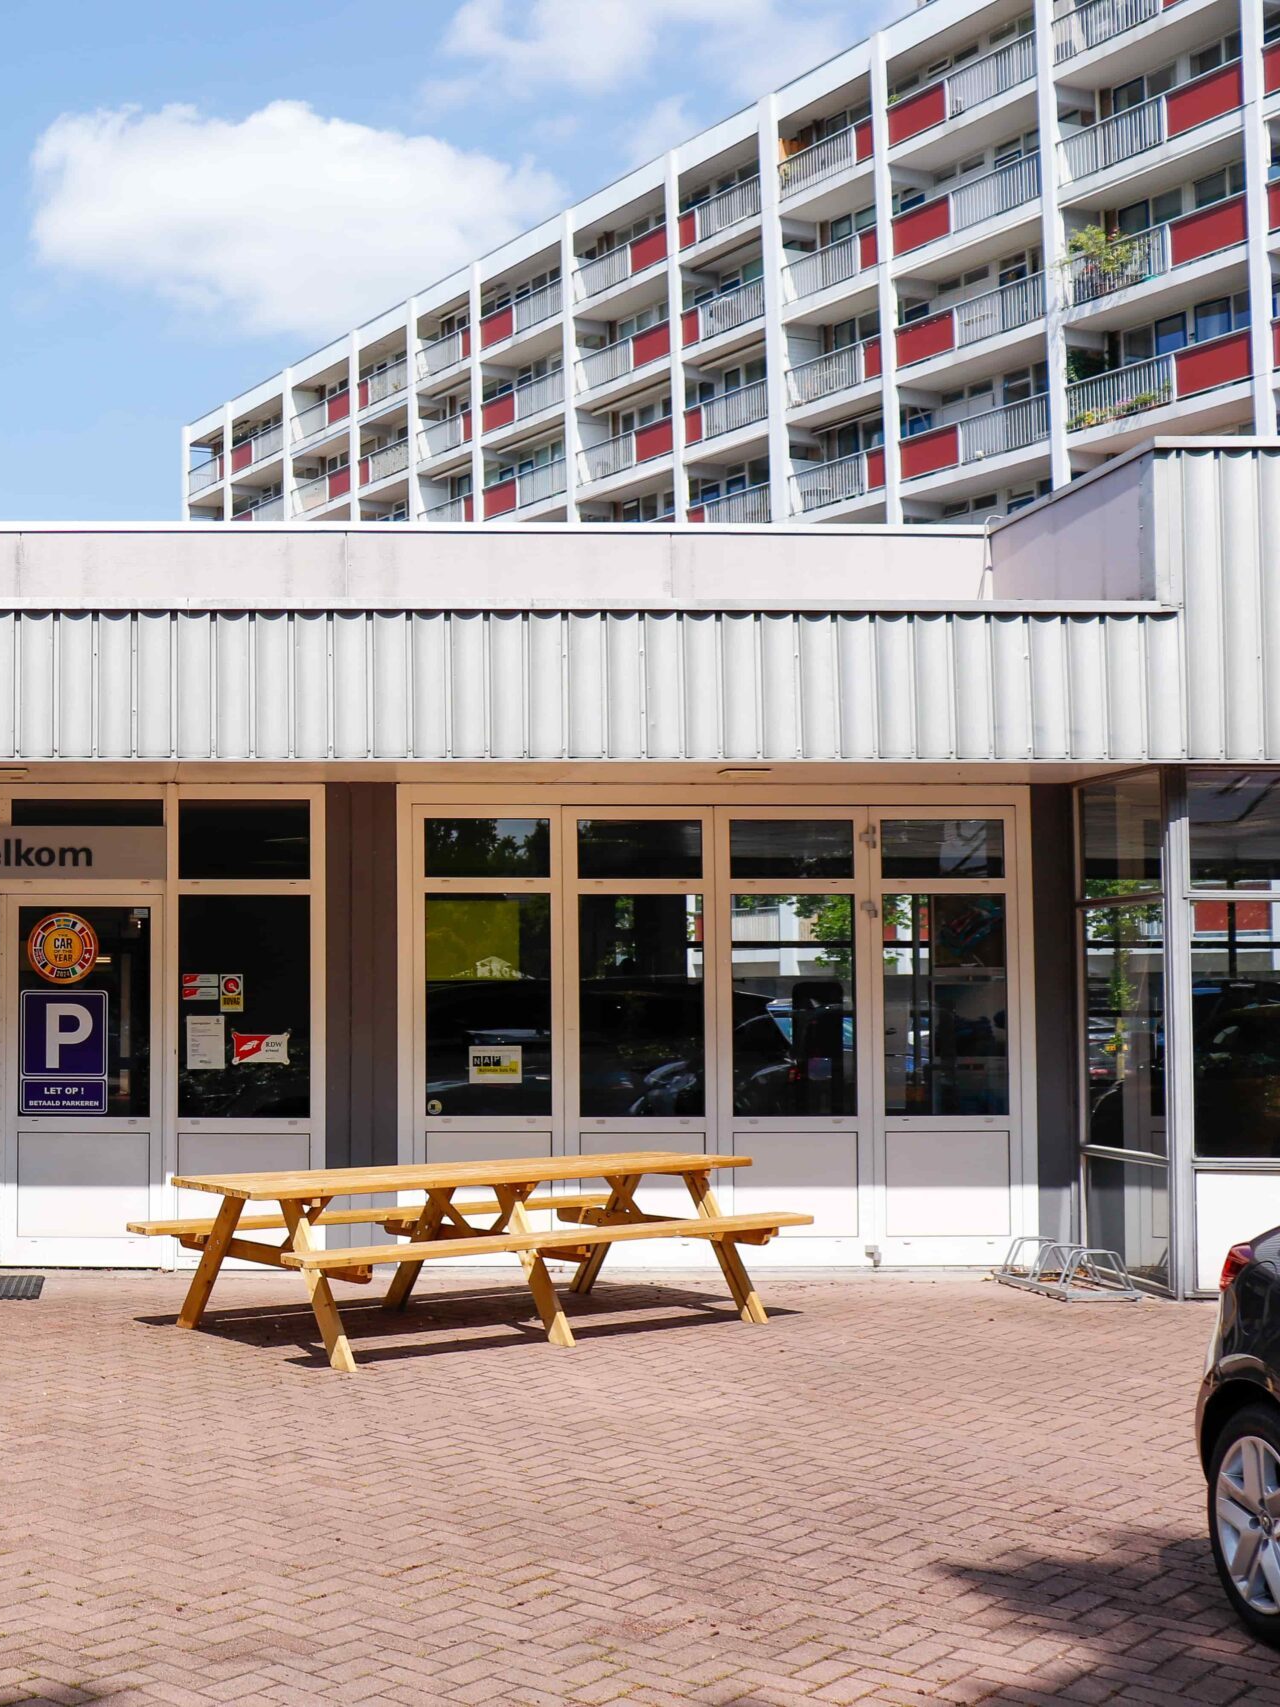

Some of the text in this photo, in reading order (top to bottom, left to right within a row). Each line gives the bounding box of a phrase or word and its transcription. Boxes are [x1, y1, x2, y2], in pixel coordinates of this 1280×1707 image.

[53, 937, 73, 949] CAR
[53, 953, 73, 962] YEAR
[45, 1003, 93, 1069] P
[473, 1056, 500, 1066] NAP
[44, 1087, 62, 1095] LET
[65, 1087, 79, 1095] OP
